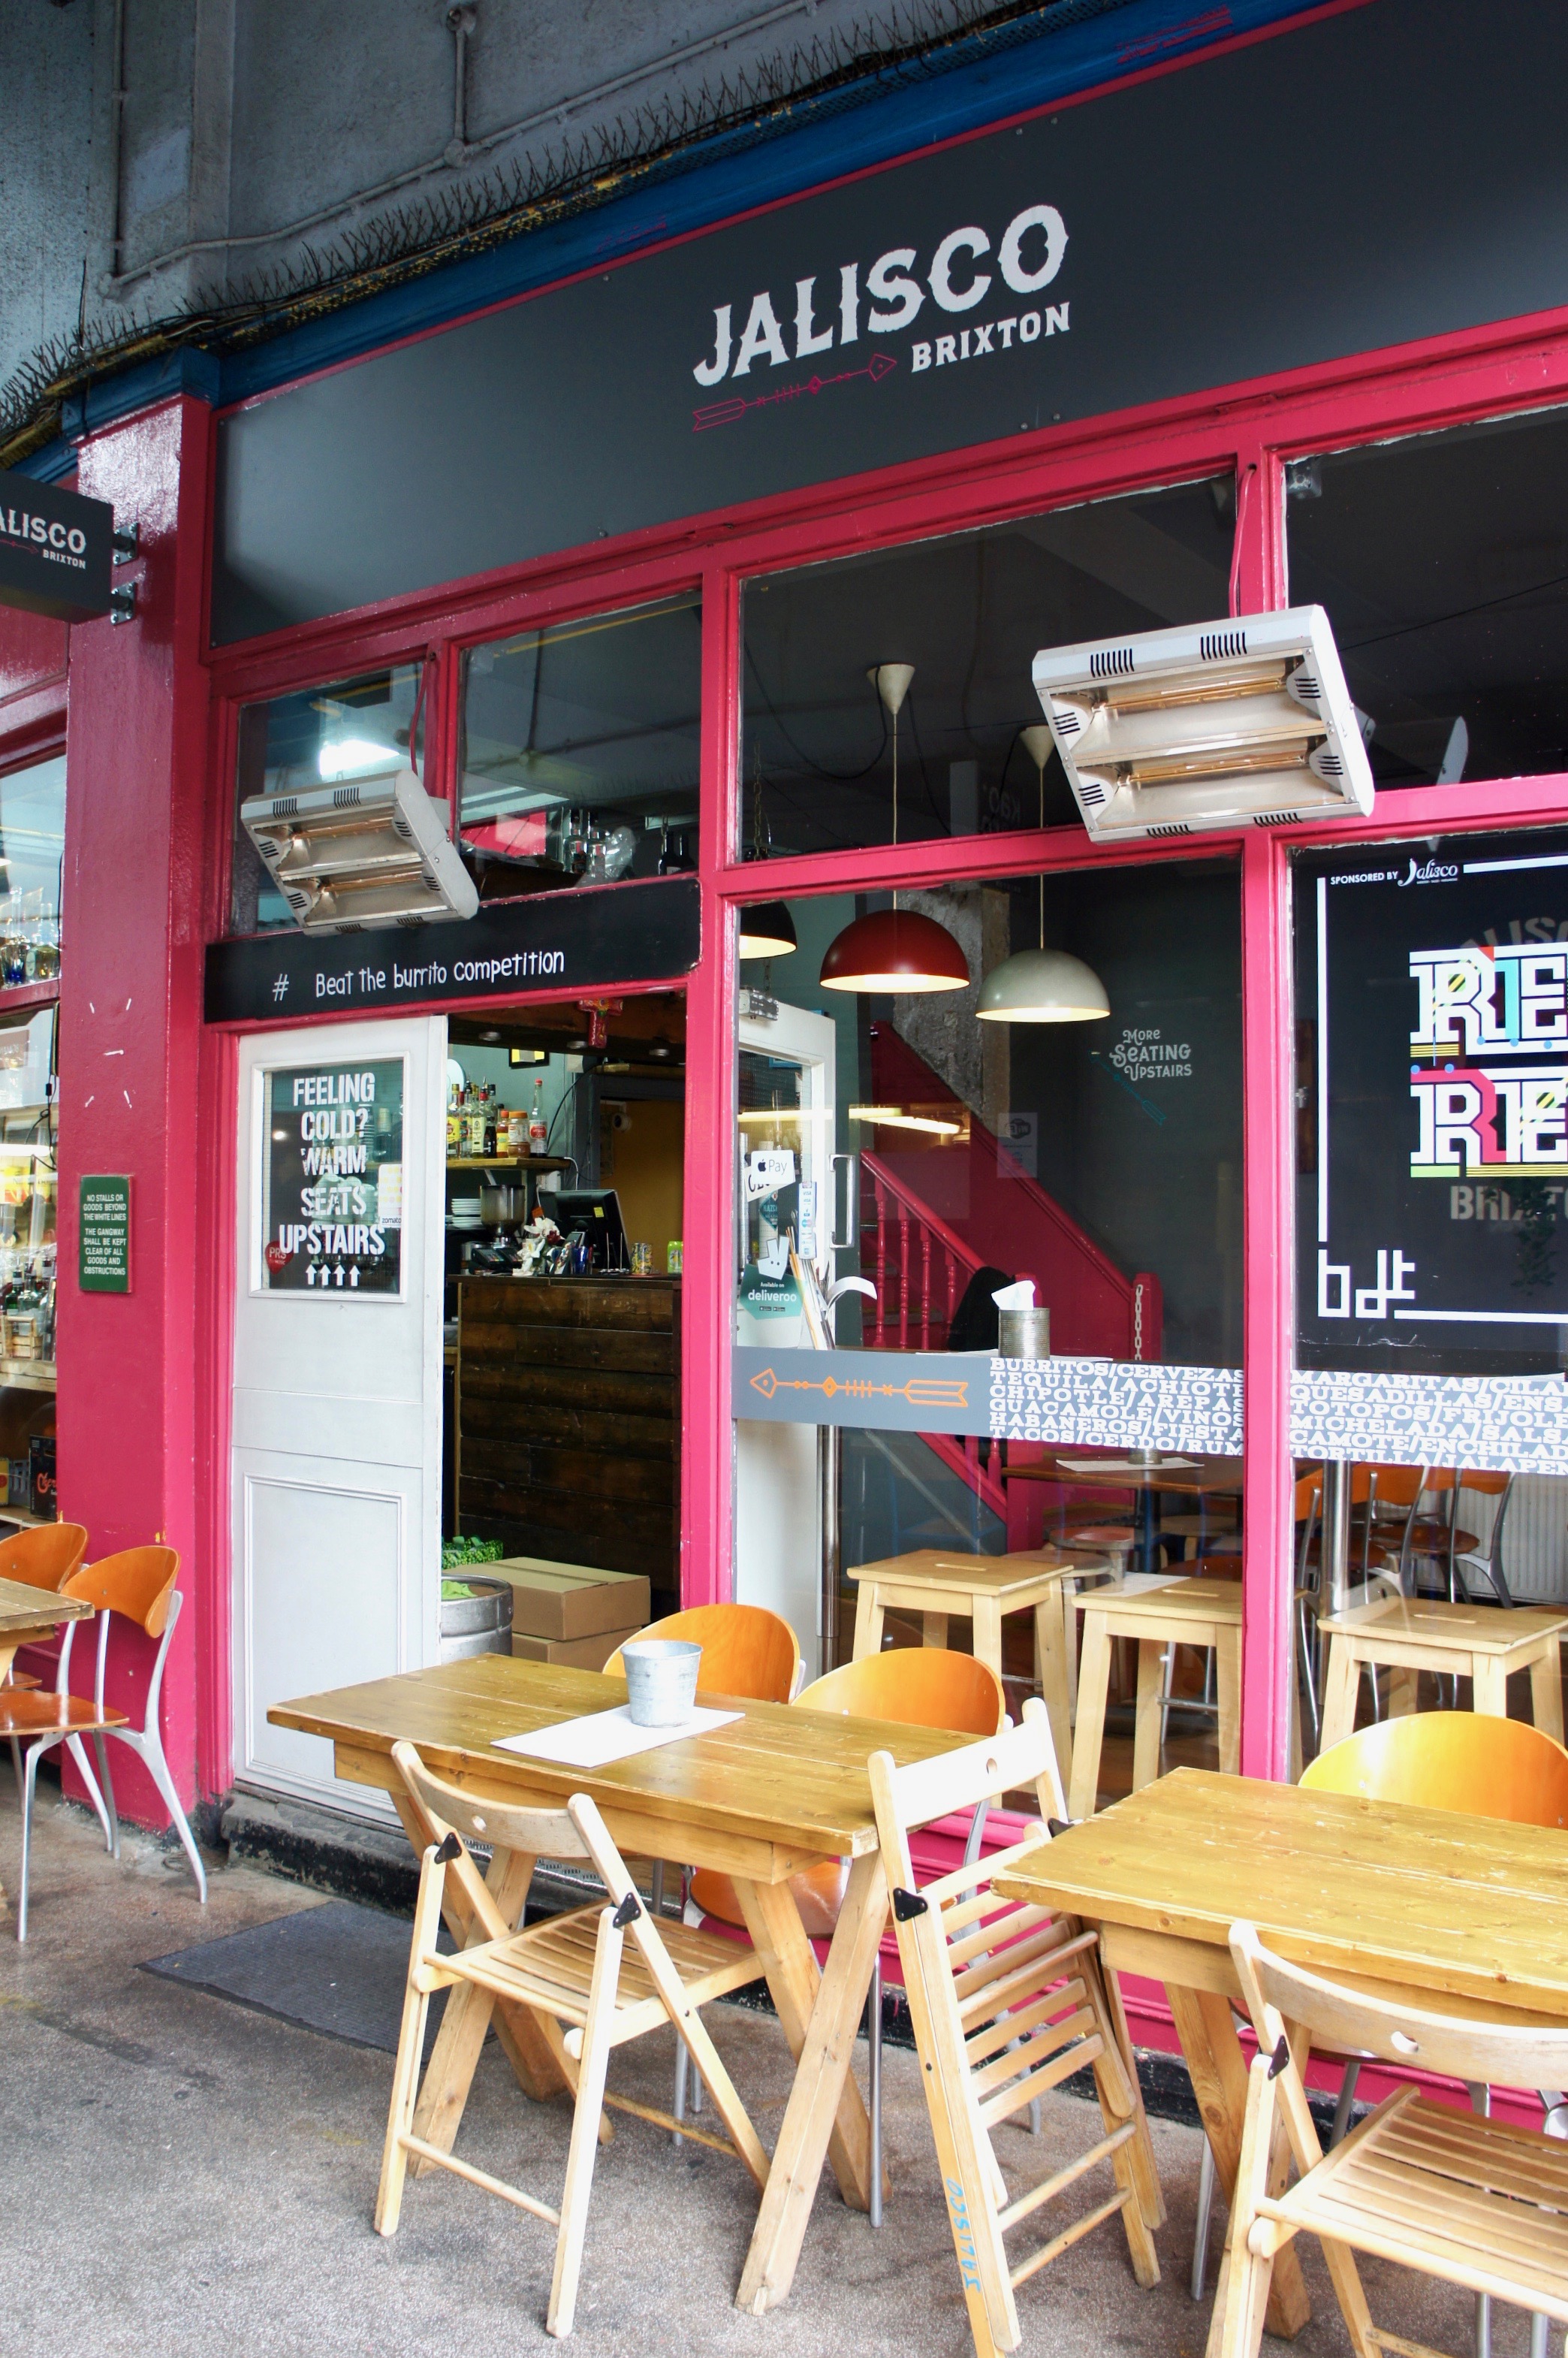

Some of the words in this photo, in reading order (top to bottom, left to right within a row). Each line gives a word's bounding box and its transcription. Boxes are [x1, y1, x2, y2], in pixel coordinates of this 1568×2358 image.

[692, 204, 1069, 387] JALISCO
[911, 301, 1070, 373] BRIXTON
[43, 548, 86, 569] BRIXTON
[1331, 873, 1385, 885] SPONSORED
[1387, 871, 1398, 880] BY
[1397, 858, 1458, 887] Jalisco
[272, 974, 290, 1001] #
[315, 971, 354, 998] Beat
[359, 967, 386, 992] the
[394, 961, 448, 989] burrito
[454, 951, 565, 983] competition
[293, 1072, 376, 1107] FEELING
[300, 1108, 369, 1141] COLD?
[300, 1145, 367, 1176] WARM
[768, 1159, 788, 1175] Pay
[83, 1203, 103, 1212] GOODS
[104, 1203, 127, 1212] BEYOND
[115, 1194, 124, 1202] OR
[300, 1186, 366, 1217] SEATS
[110, 1213, 126, 1221] LINES
[85, 1227, 96, 1236] THE
[97, 1227, 125, 1236] GANGWAY
[112, 1238, 127, 1246] KEPT
[279, 1224, 386, 1254] UPSTAIRS
[108, 1257, 121, 1265] AND
[113, 1248, 124, 1256] ALL
[83, 1267, 126, 1276] OBSTRUCTIONS
[748, 1289, 798, 1302] deliveroo
[946, 2178, 982, 2293] JALISCO
